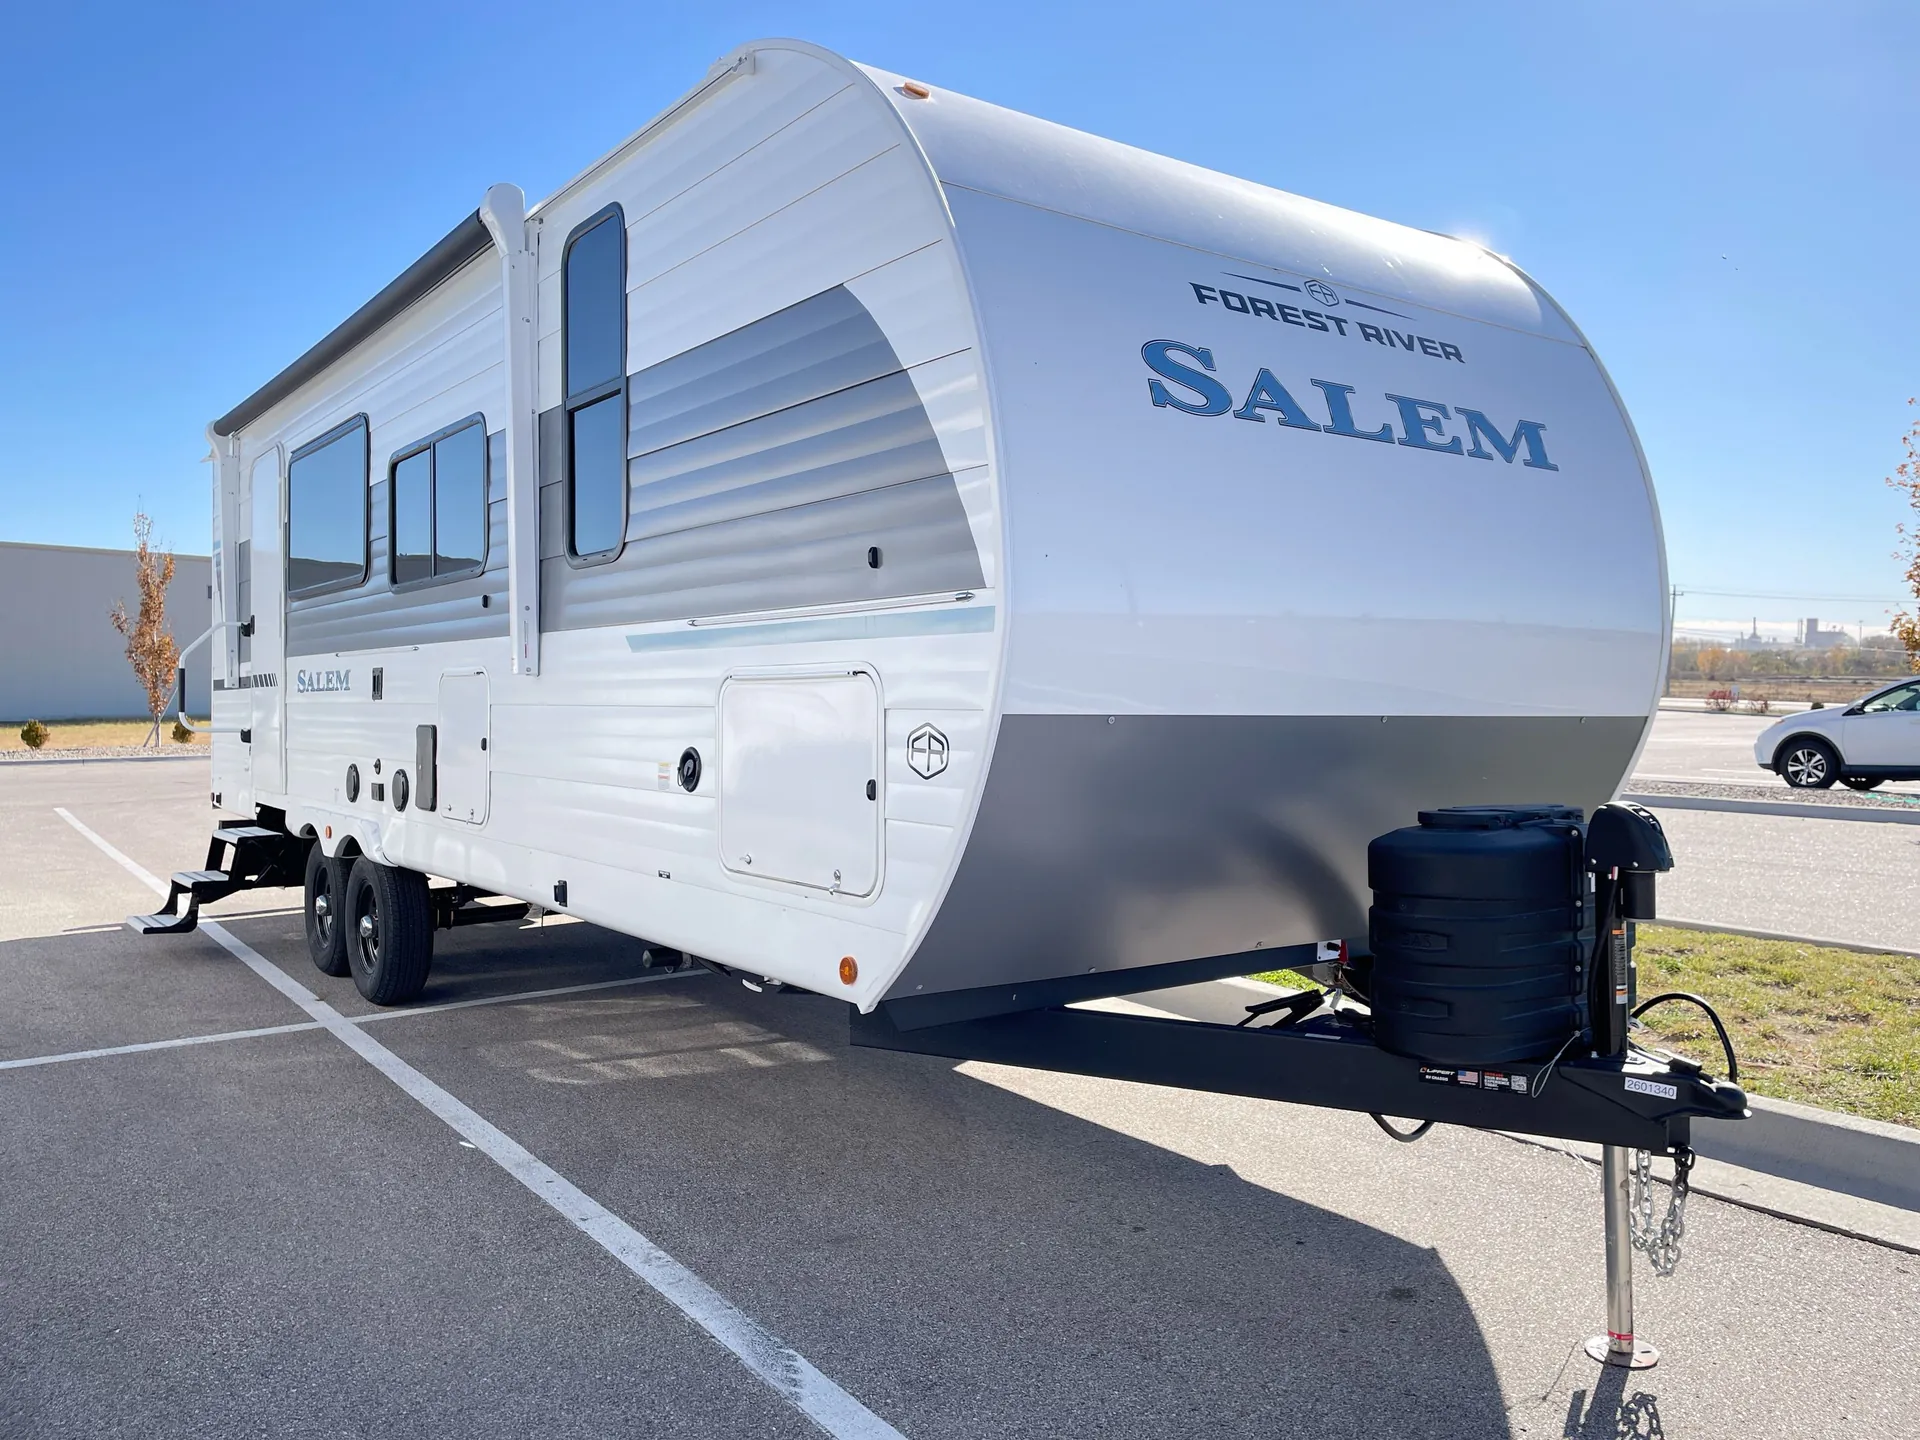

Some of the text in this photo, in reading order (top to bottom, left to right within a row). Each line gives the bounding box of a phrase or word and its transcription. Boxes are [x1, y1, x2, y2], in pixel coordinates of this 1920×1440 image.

[1189, 281, 1466, 364] FOREST RIVER
[1141, 338, 1559, 472] SALEM
[297, 669, 351, 693] SALEM
[1627, 1079, 1675, 1097] 2601340
